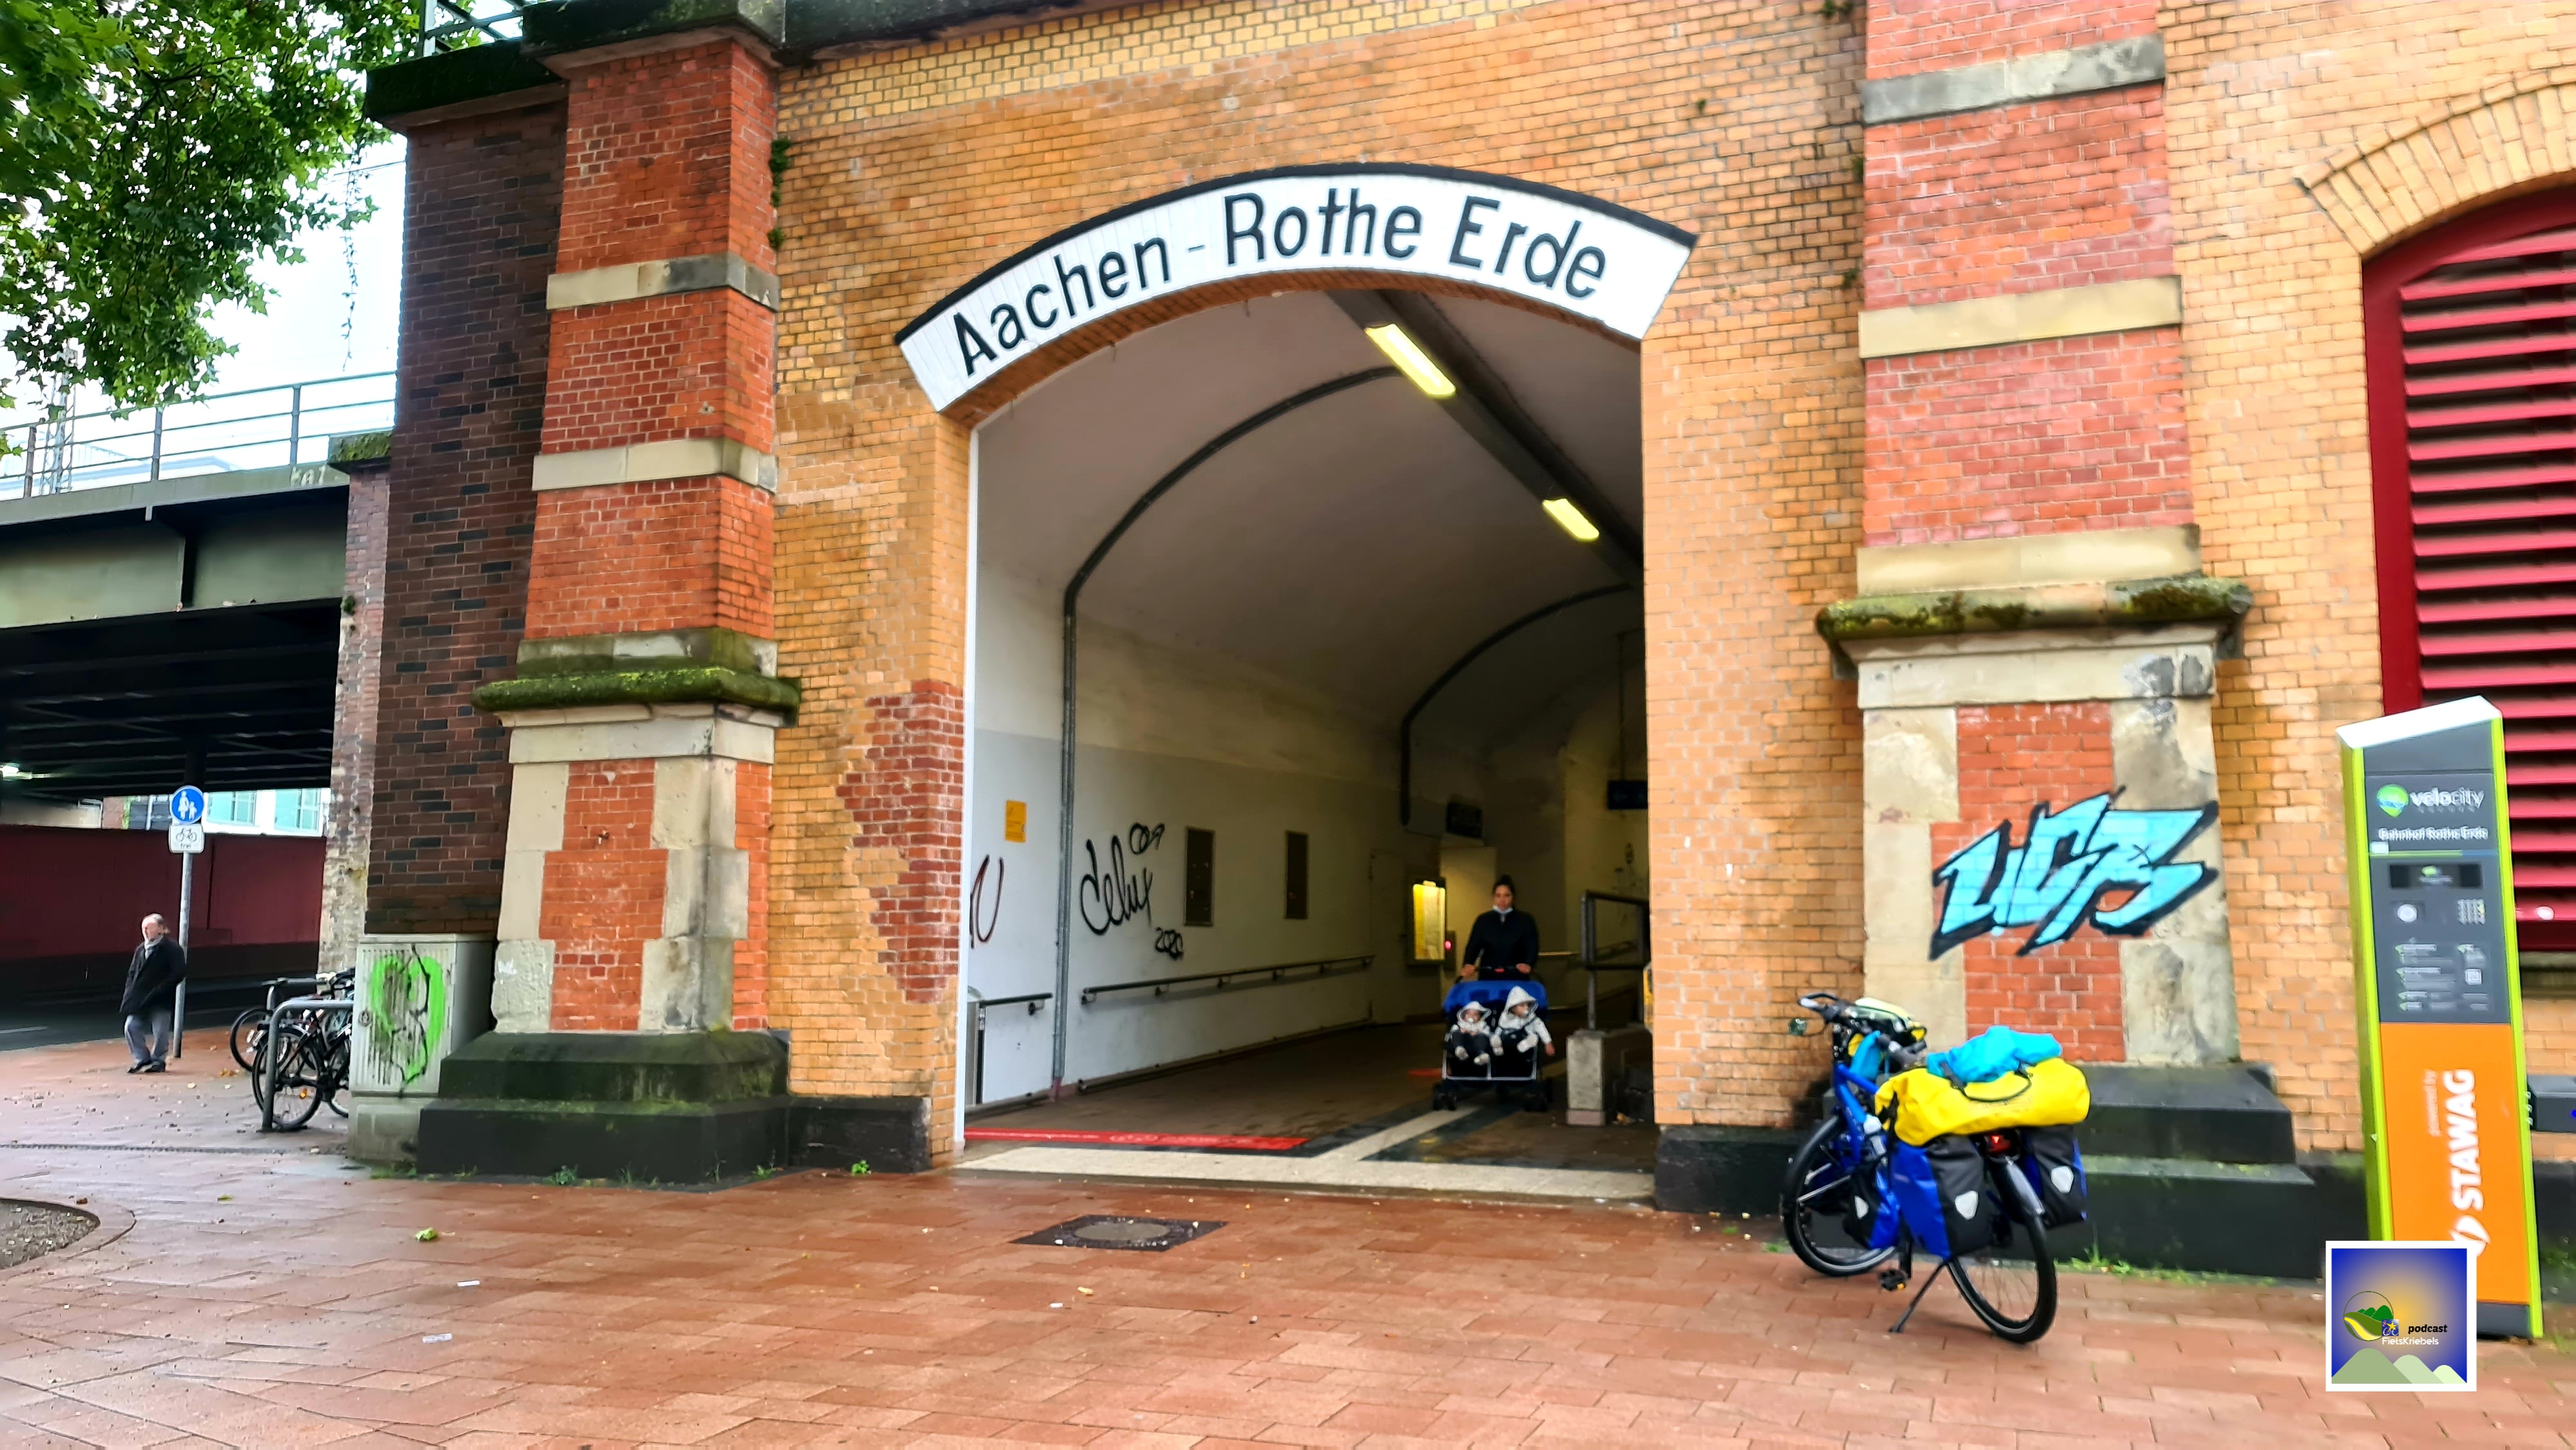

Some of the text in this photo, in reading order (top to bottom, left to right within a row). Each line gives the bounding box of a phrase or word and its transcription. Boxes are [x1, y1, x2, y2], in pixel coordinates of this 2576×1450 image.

[952, 236, 1171, 377] Aachen
[1224, 187, 1422, 266] Rothe
[1448, 195, 1605, 299] Erde
[2409, 787, 2485, 809] velocity
[2443, 1068, 2485, 1211] STAWAG
